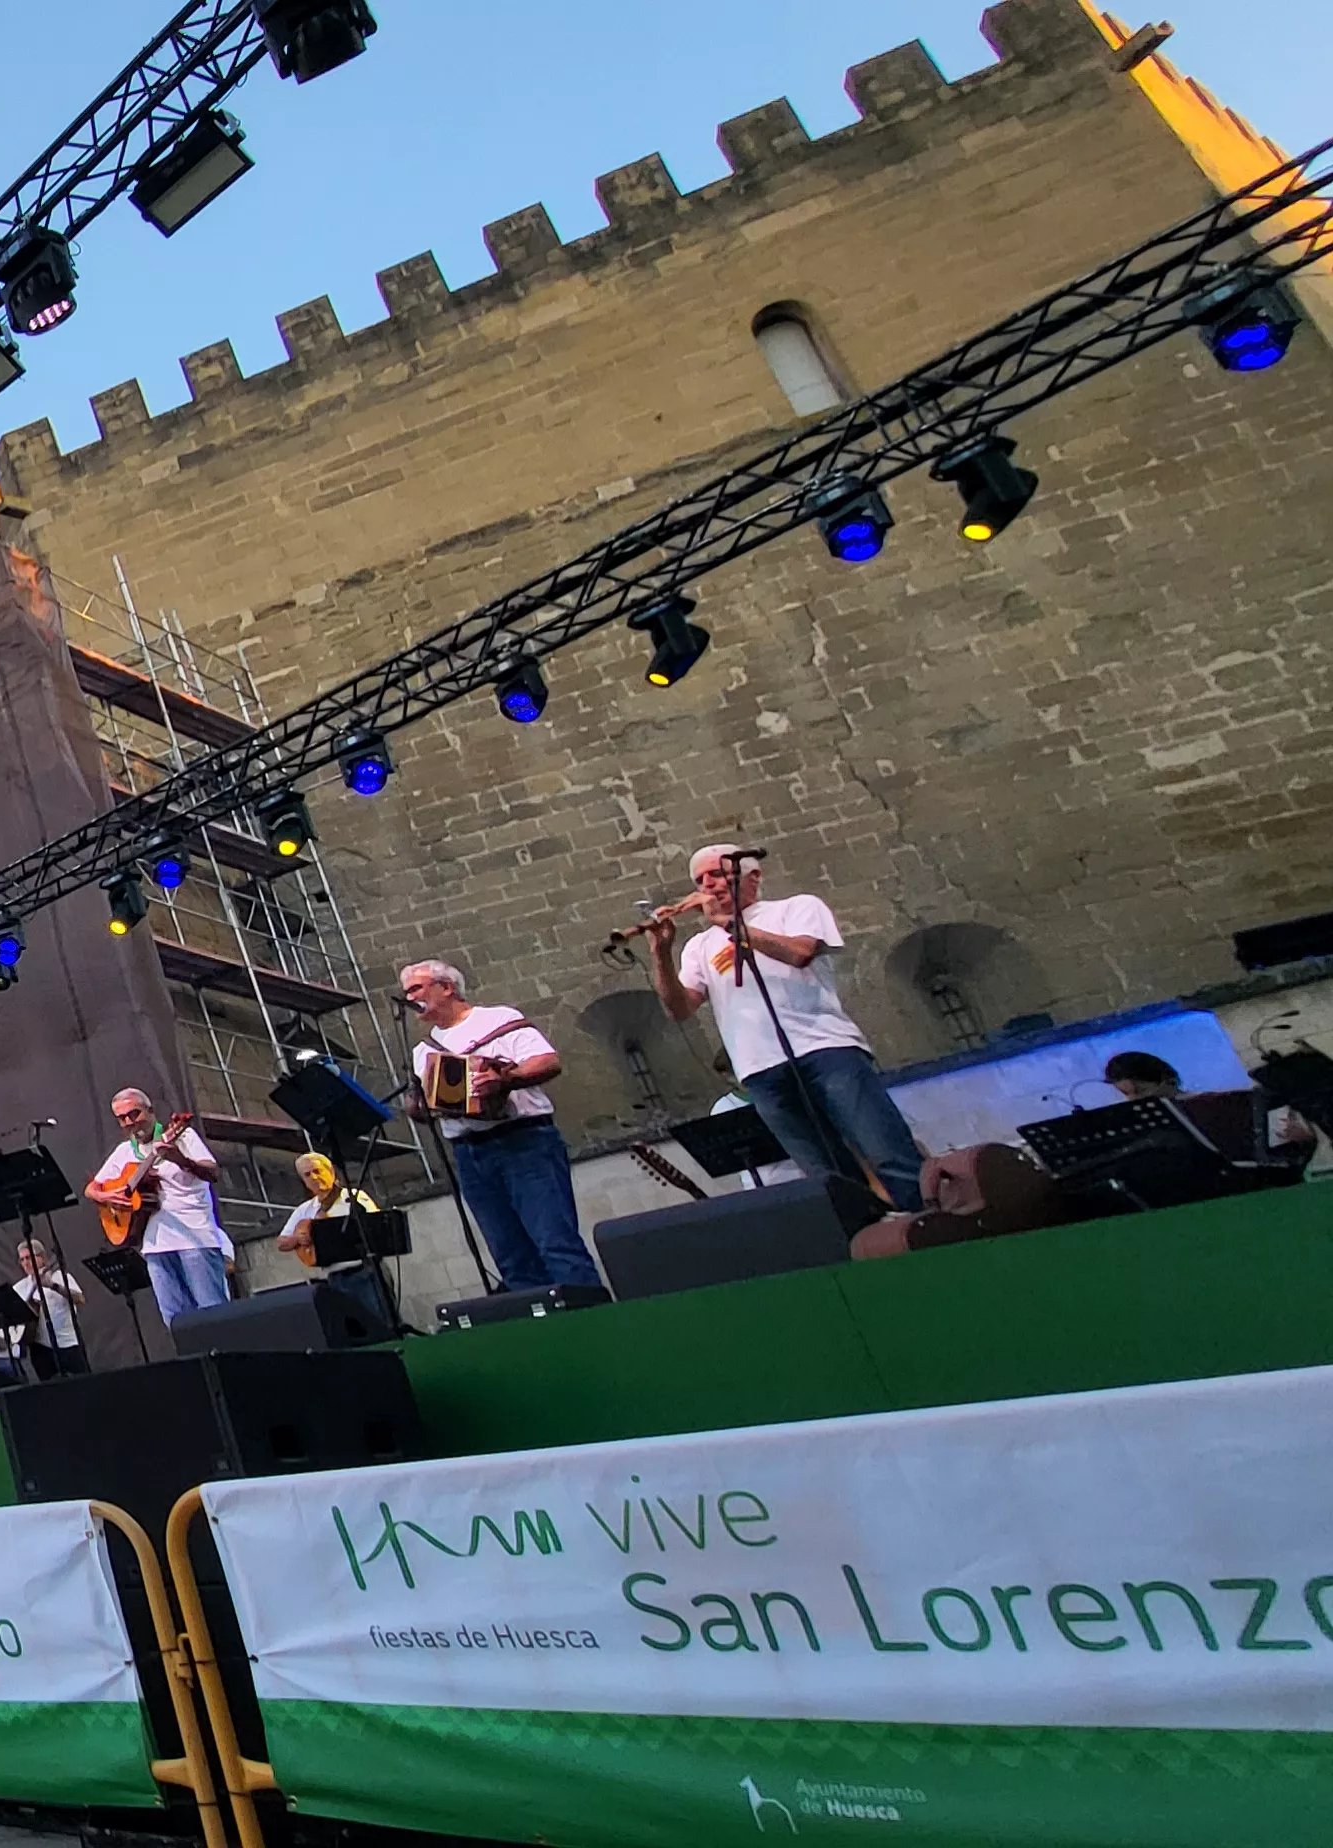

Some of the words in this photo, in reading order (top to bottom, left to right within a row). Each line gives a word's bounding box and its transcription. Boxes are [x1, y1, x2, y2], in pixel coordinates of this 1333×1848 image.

[585, 1475, 778, 1553] vive
[622, 1572, 821, 1652] San
[369, 1624, 451, 1649] fiestas
[456, 1623, 488, 1649] de
[491, 1623, 600, 1650] Huesca
[796, 1778, 927, 1803] Ayuntamiento
[800, 1798, 822, 1815] de
[826, 1798, 901, 1821] Huesca
